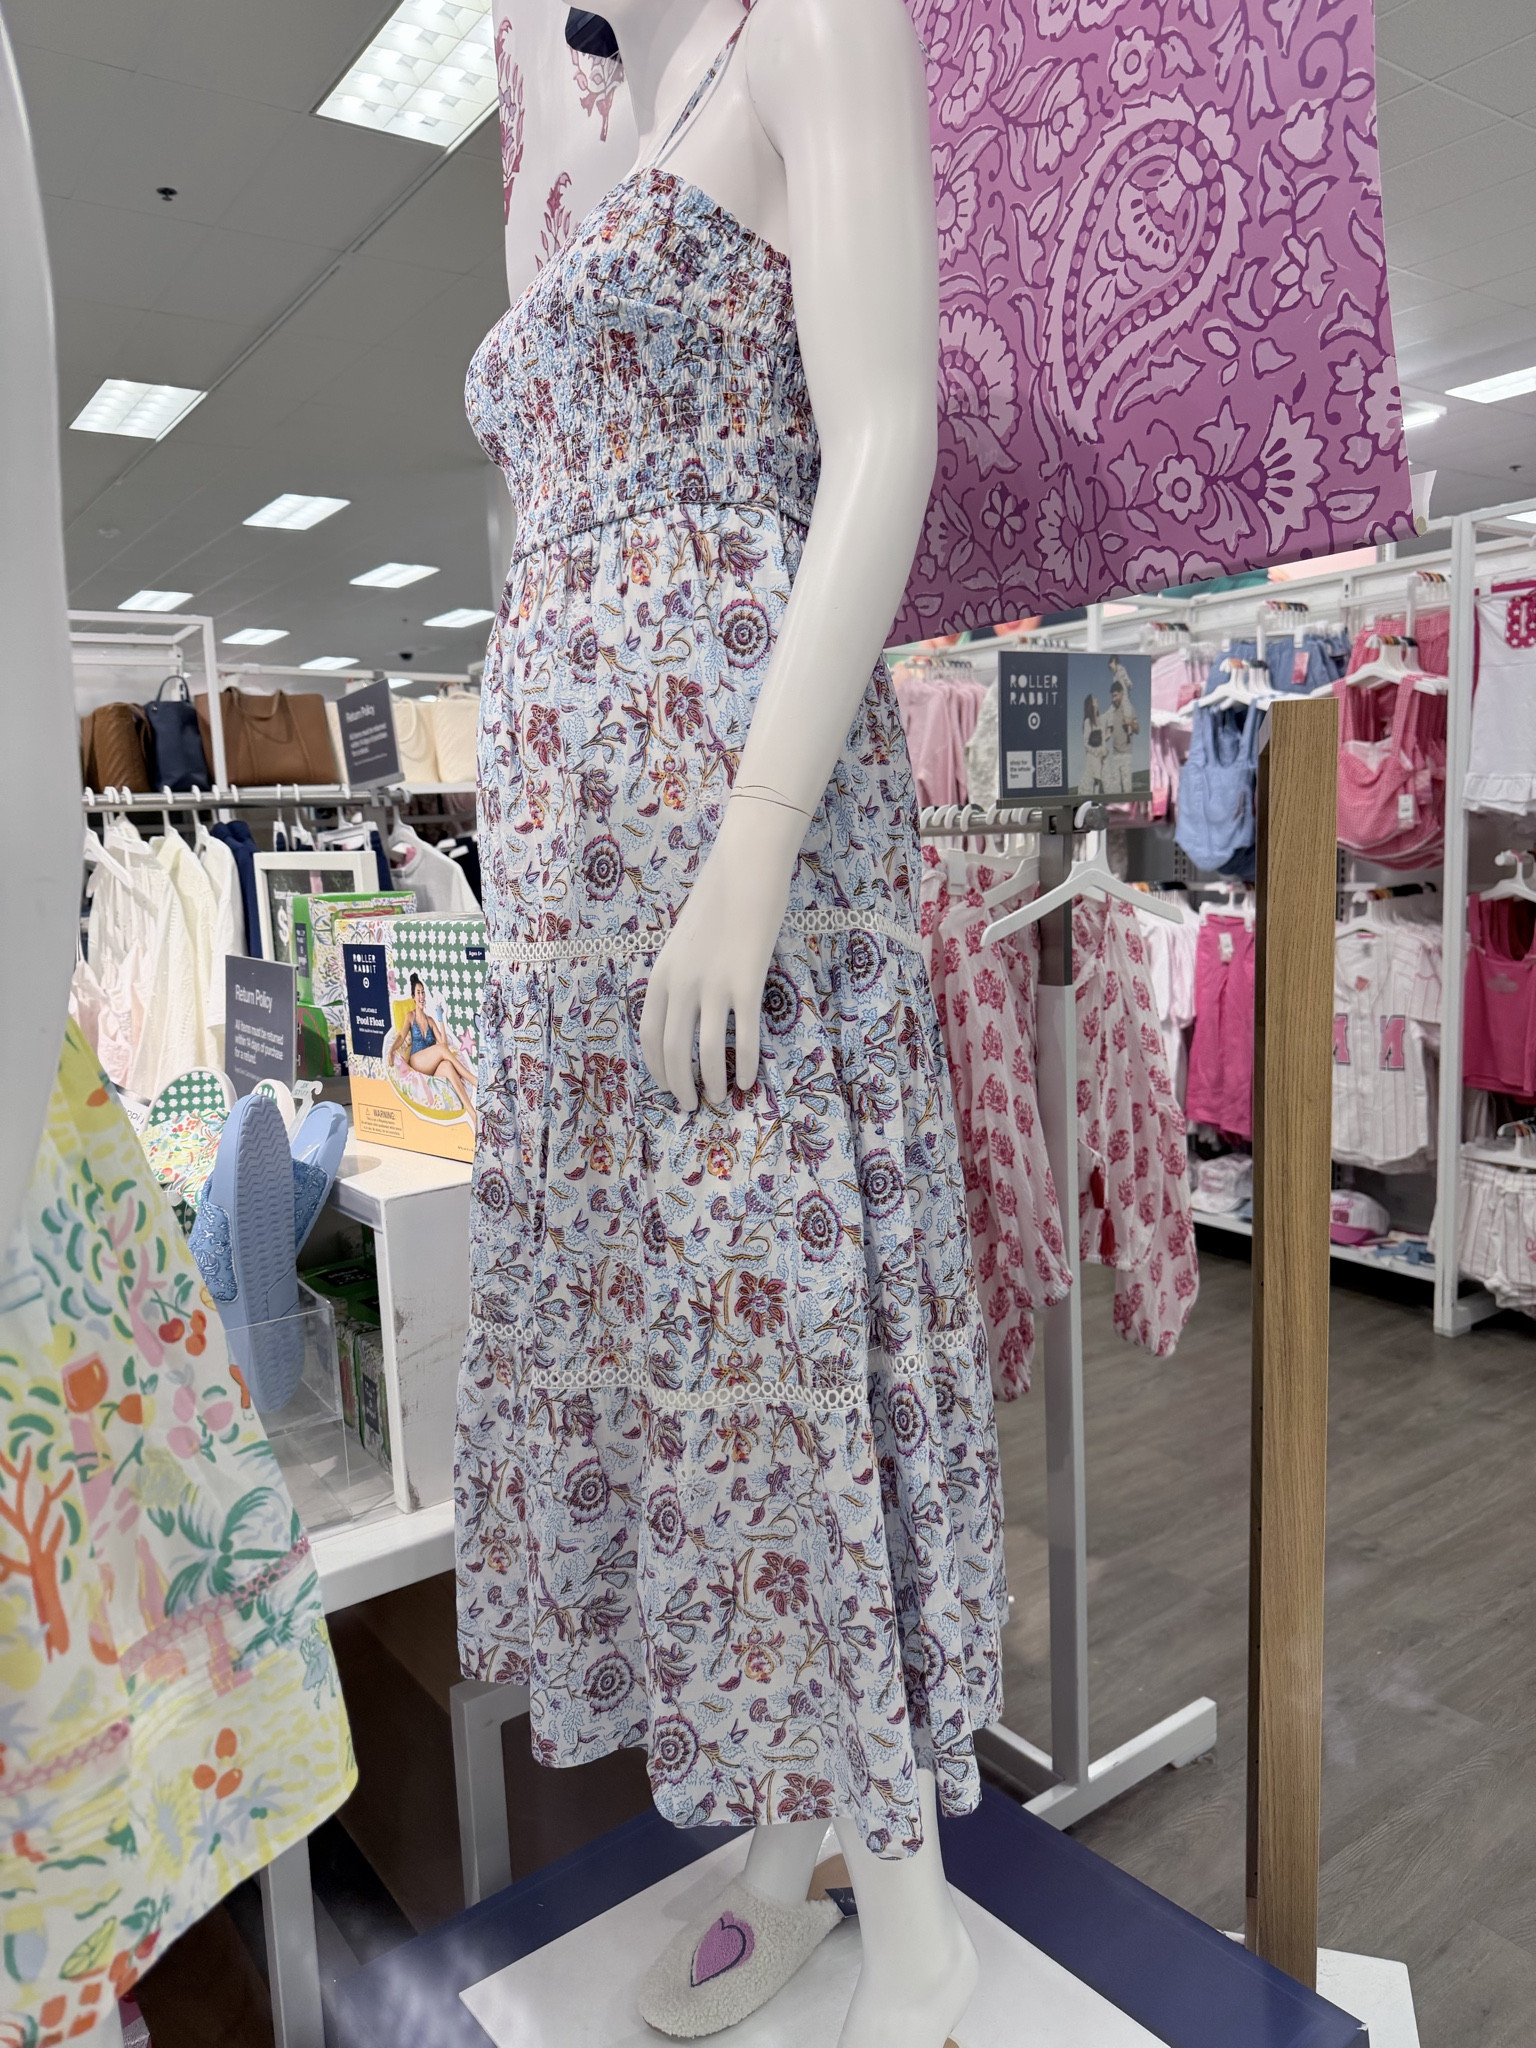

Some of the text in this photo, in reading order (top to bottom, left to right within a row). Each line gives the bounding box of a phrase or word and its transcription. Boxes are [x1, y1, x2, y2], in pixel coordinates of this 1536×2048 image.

[1010, 674, 1058, 689] ROLLER
[1010, 691, 1058, 706] RABBIT
[352, 953, 376, 964] ROLLER
[353, 964, 377, 974] RABBIT
[235, 984, 272, 1013] Return Policy
[355, 1015, 385, 1027] Pool Float
